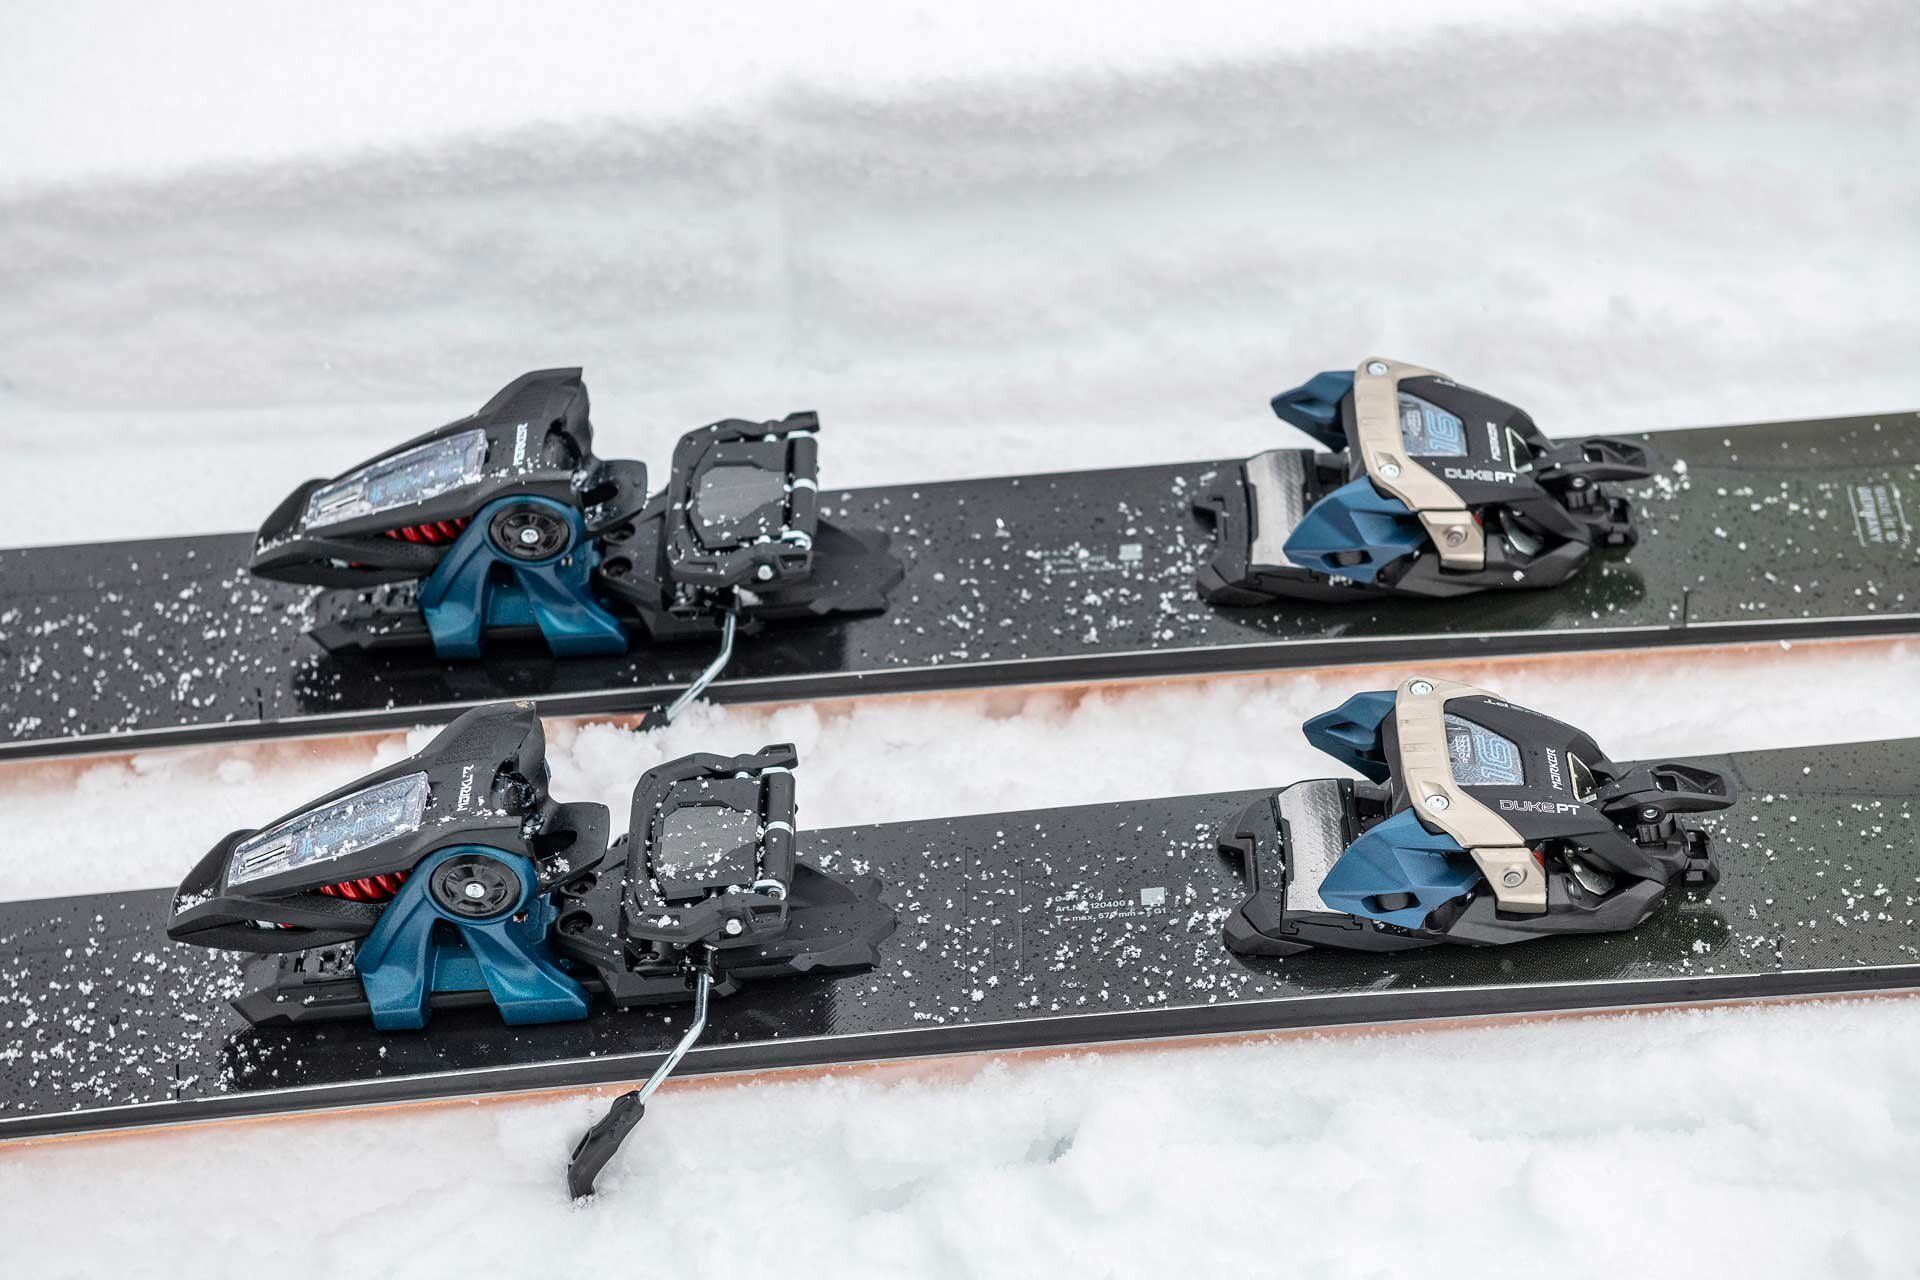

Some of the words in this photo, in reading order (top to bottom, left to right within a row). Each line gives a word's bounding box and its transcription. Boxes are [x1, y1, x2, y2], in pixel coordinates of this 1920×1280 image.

[1495, 471, 1517, 484] PT
[1545, 747, 1563, 790] MARKER
[1556, 803, 1580, 816] PT
[1090, 900, 1126, 909] 120400
